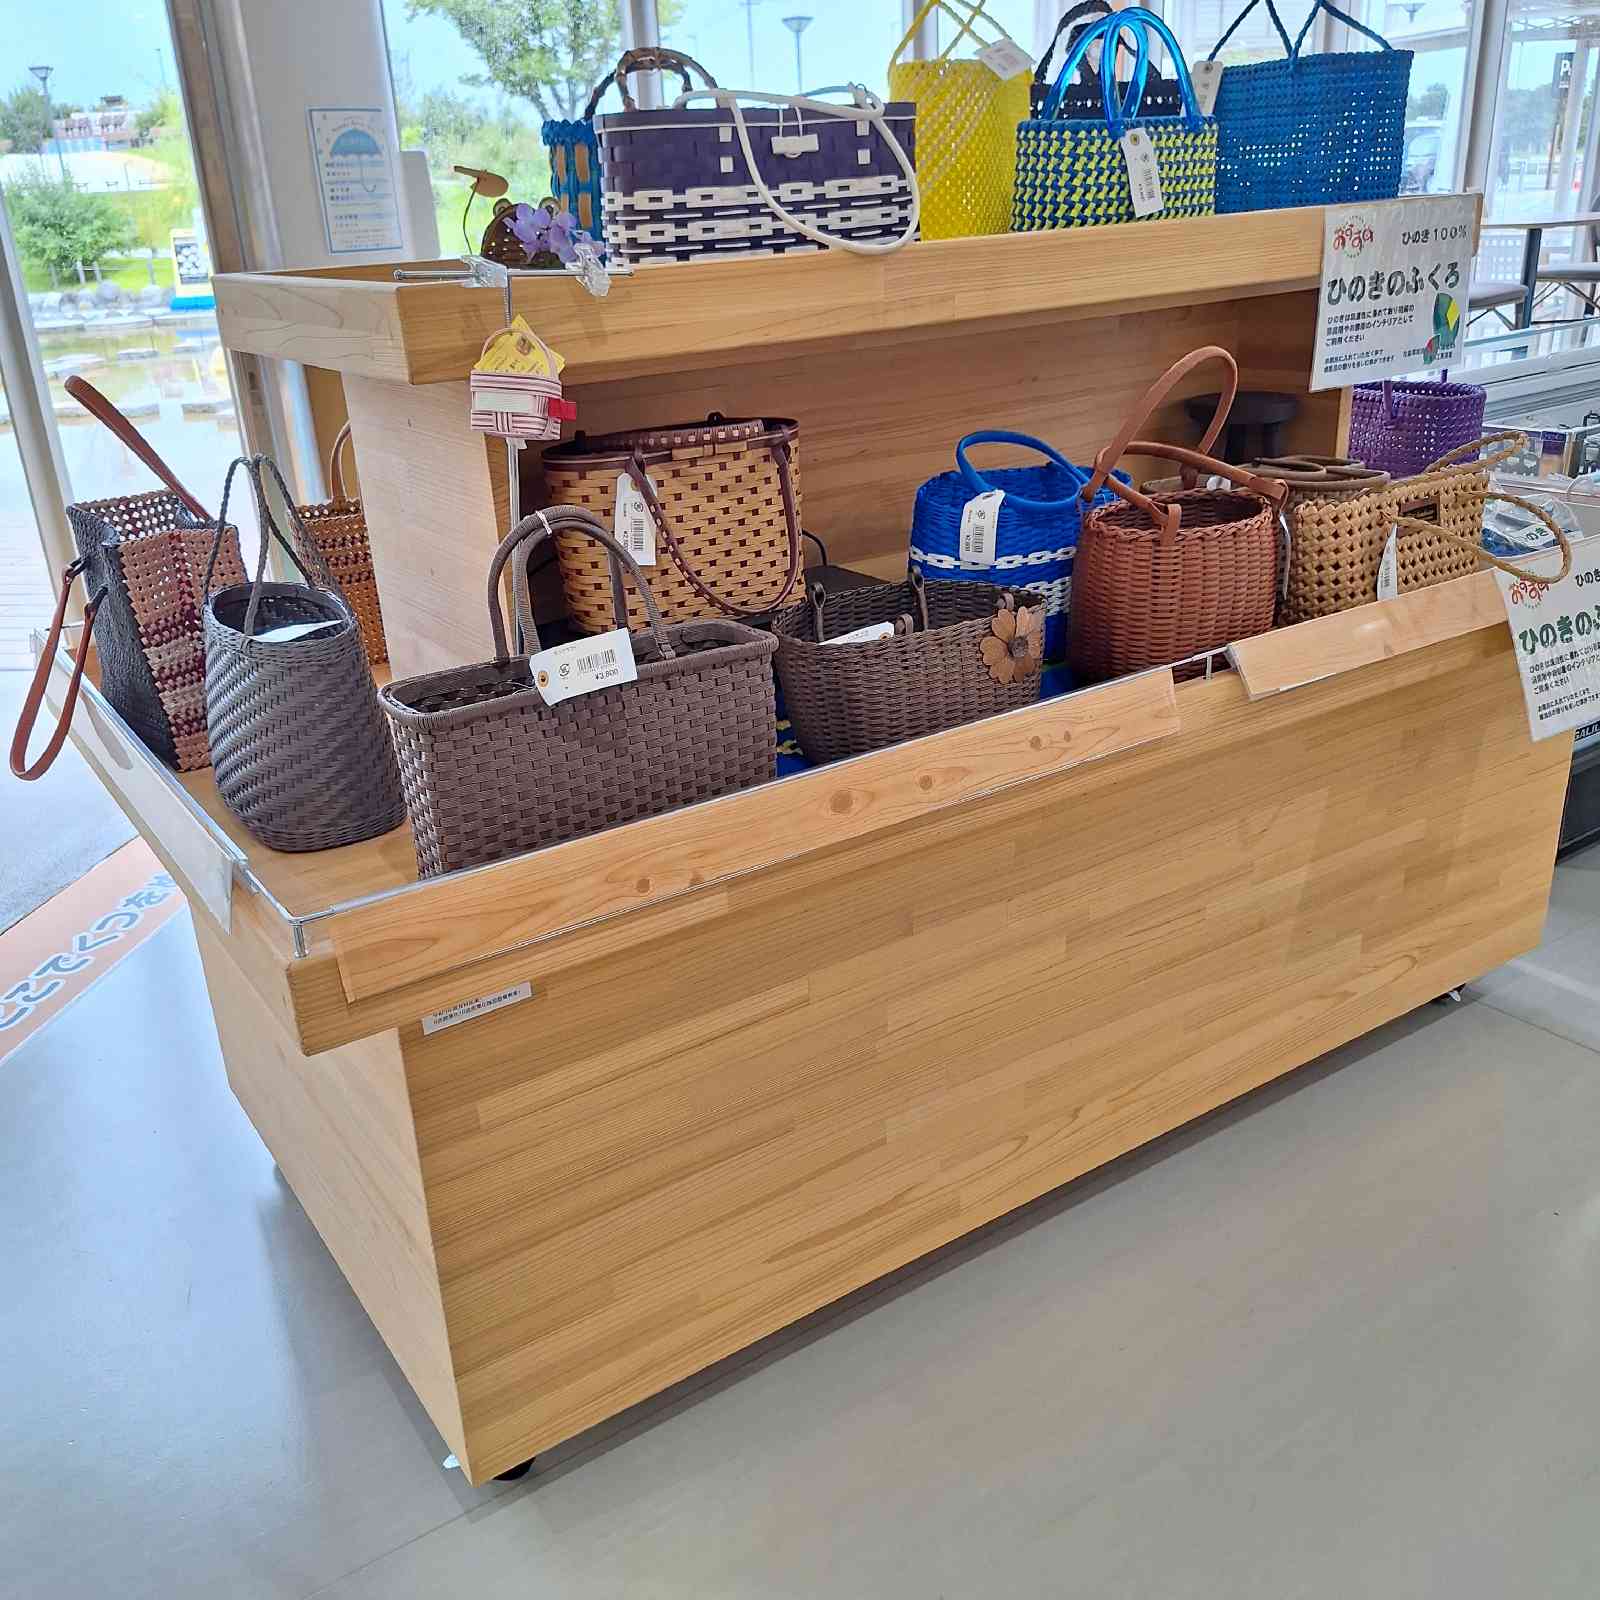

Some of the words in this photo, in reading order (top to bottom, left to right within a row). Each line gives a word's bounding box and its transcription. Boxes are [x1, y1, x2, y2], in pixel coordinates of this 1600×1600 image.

[1327, 262, 1459, 305] ひのきのふくろ
